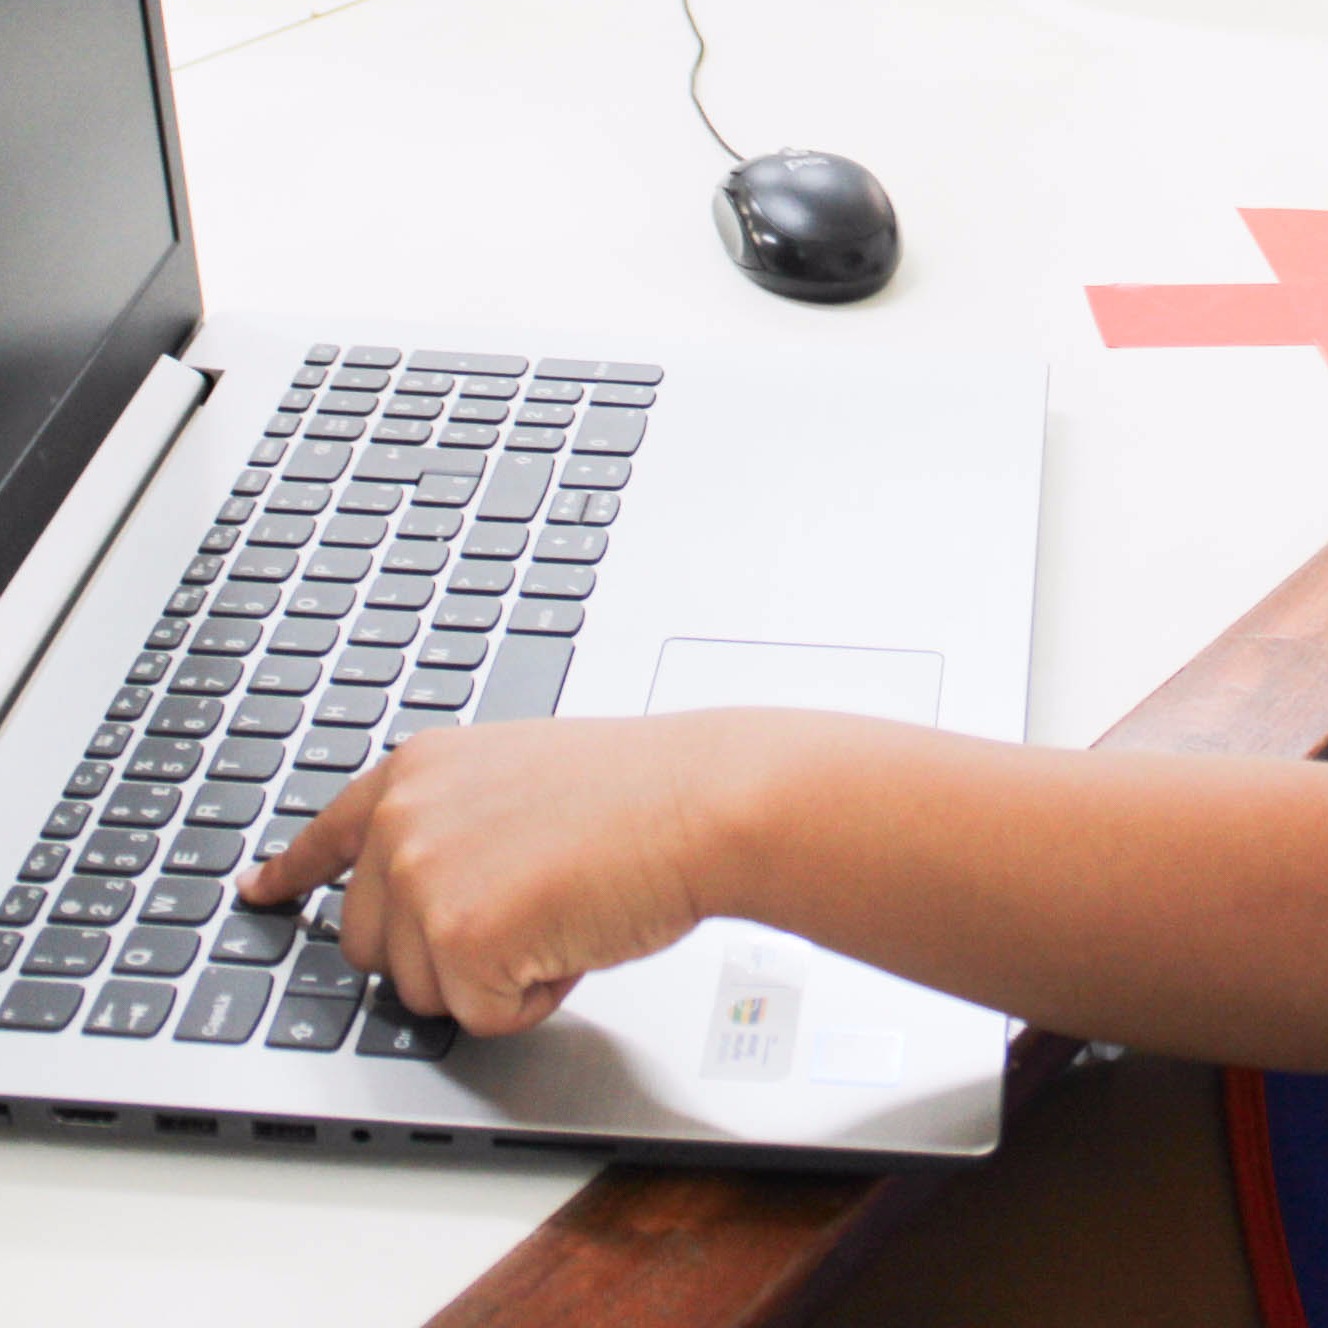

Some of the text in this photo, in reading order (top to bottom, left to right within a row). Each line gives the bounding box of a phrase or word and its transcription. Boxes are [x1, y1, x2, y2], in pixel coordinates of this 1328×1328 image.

[297, 598, 318, 610] O
[359, 628, 382, 639] K
[343, 667, 364, 677] J
[204, 677, 225, 688] 7
[257, 675, 281, 686] U
[323, 705, 347, 717] H
[183, 719, 205, 729] 6
[238, 714, 261, 727] Y
[305, 747, 329, 761] G
[162, 762, 184, 773] 5
[216, 759, 241, 771] T
[284, 793, 307, 807] F
[139, 808, 161, 819] 4
[195, 804, 222, 818] R
[263, 840, 290, 854] D
[114, 854, 137, 867] 3
[172, 850, 200, 865] E
[89, 903, 113, 917] 2
[148, 894, 178, 914] W
[221, 938, 249, 955] A
[125, 948, 153, 966] Q
